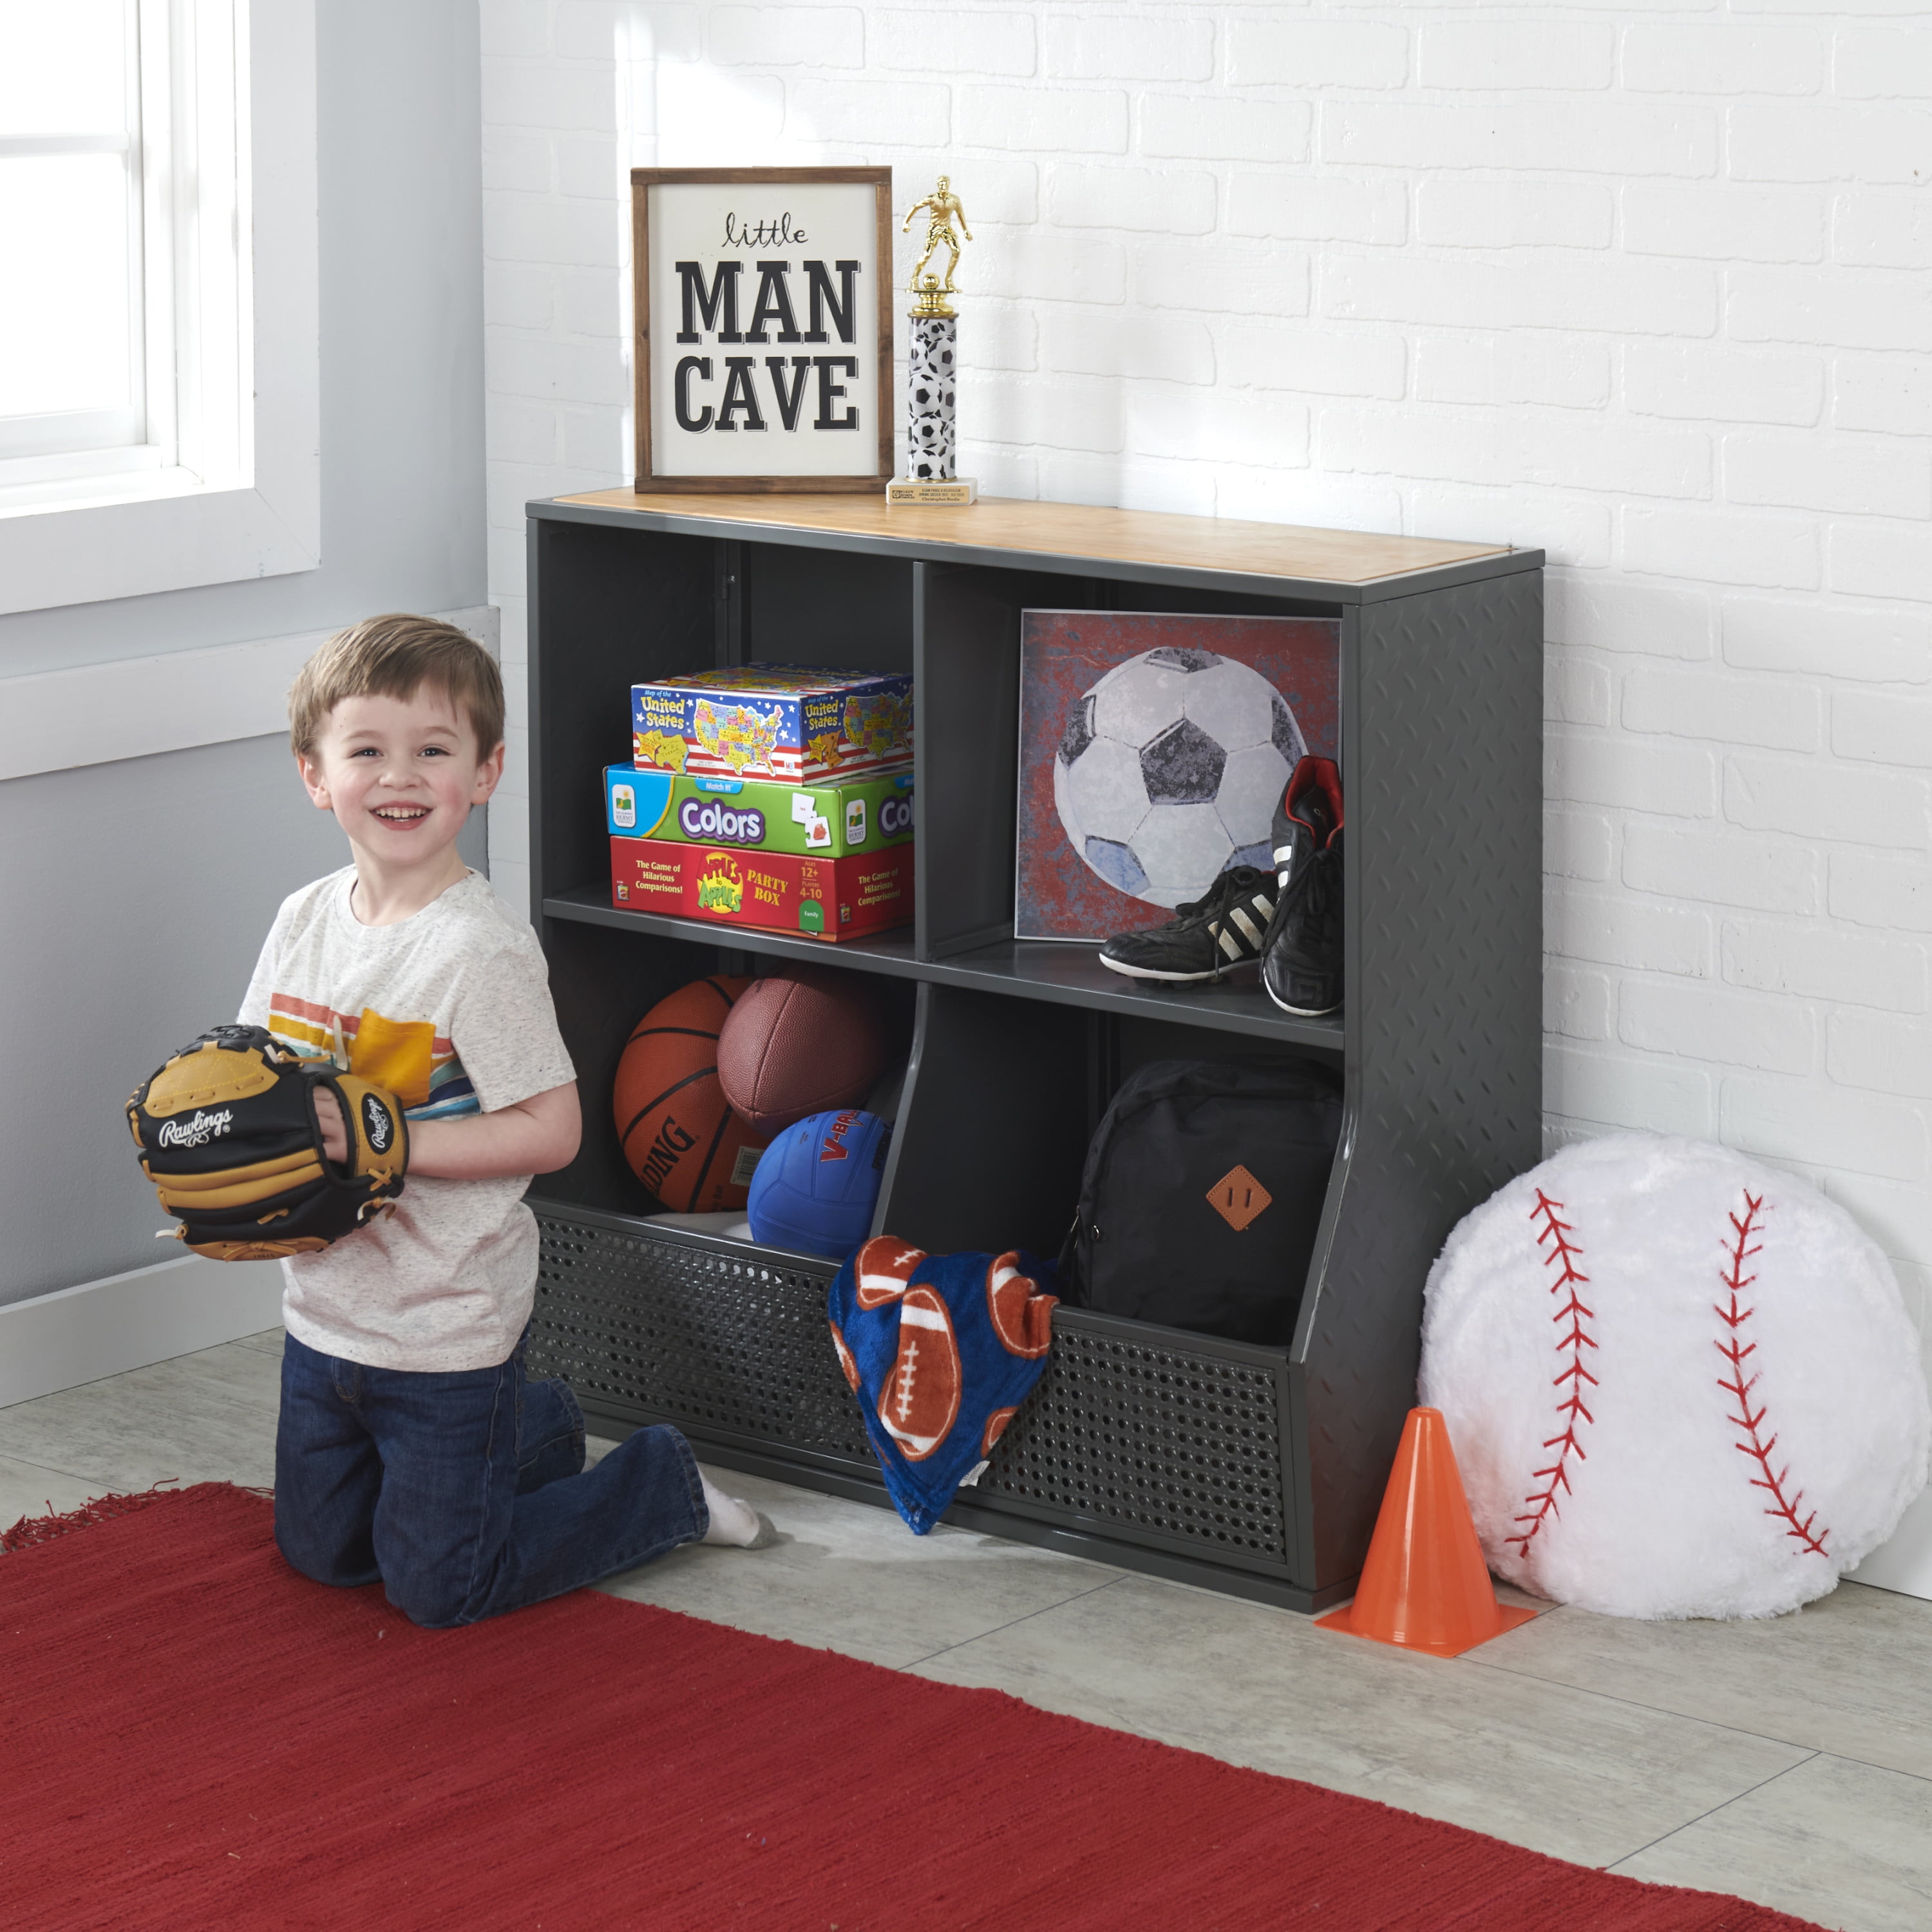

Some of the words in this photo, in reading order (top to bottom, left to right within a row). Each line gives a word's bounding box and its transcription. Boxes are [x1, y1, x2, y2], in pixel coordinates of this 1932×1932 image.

[722, 211, 809, 248] little
[675, 260, 862, 345] MAN
[674, 355, 860, 432] CAVE
[640, 696, 685, 715] United
[804, 699, 839, 718] United
[646, 712, 685, 730] States
[809, 715, 838, 730] States
[682, 802, 761, 838] Colors
[881, 795, 914, 832] Col
[636, 860, 650, 869] The
[650, 862, 672, 871] Game
[673, 864, 681, 873] of
[800, 867, 819, 877] 12+
[858, 876, 871, 884] The
[872, 871, 890, 881] Game
[891, 867, 899, 876] of
[643, 871, 675, 882] Hilarious
[747, 869, 788, 893] PARTY
[636, 880, 683, 894] Comparisons!
[799, 887, 822, 899] 4-10
[864, 881, 894, 894] Hilarious
[754, 887, 781, 906] BOX
[858, 889, 901, 906] Comparisons!
[804, 911, 819, 919] Family
[158, 1108, 233, 1148] Rawlings
[367, 1097, 388, 1148] Rawlings
